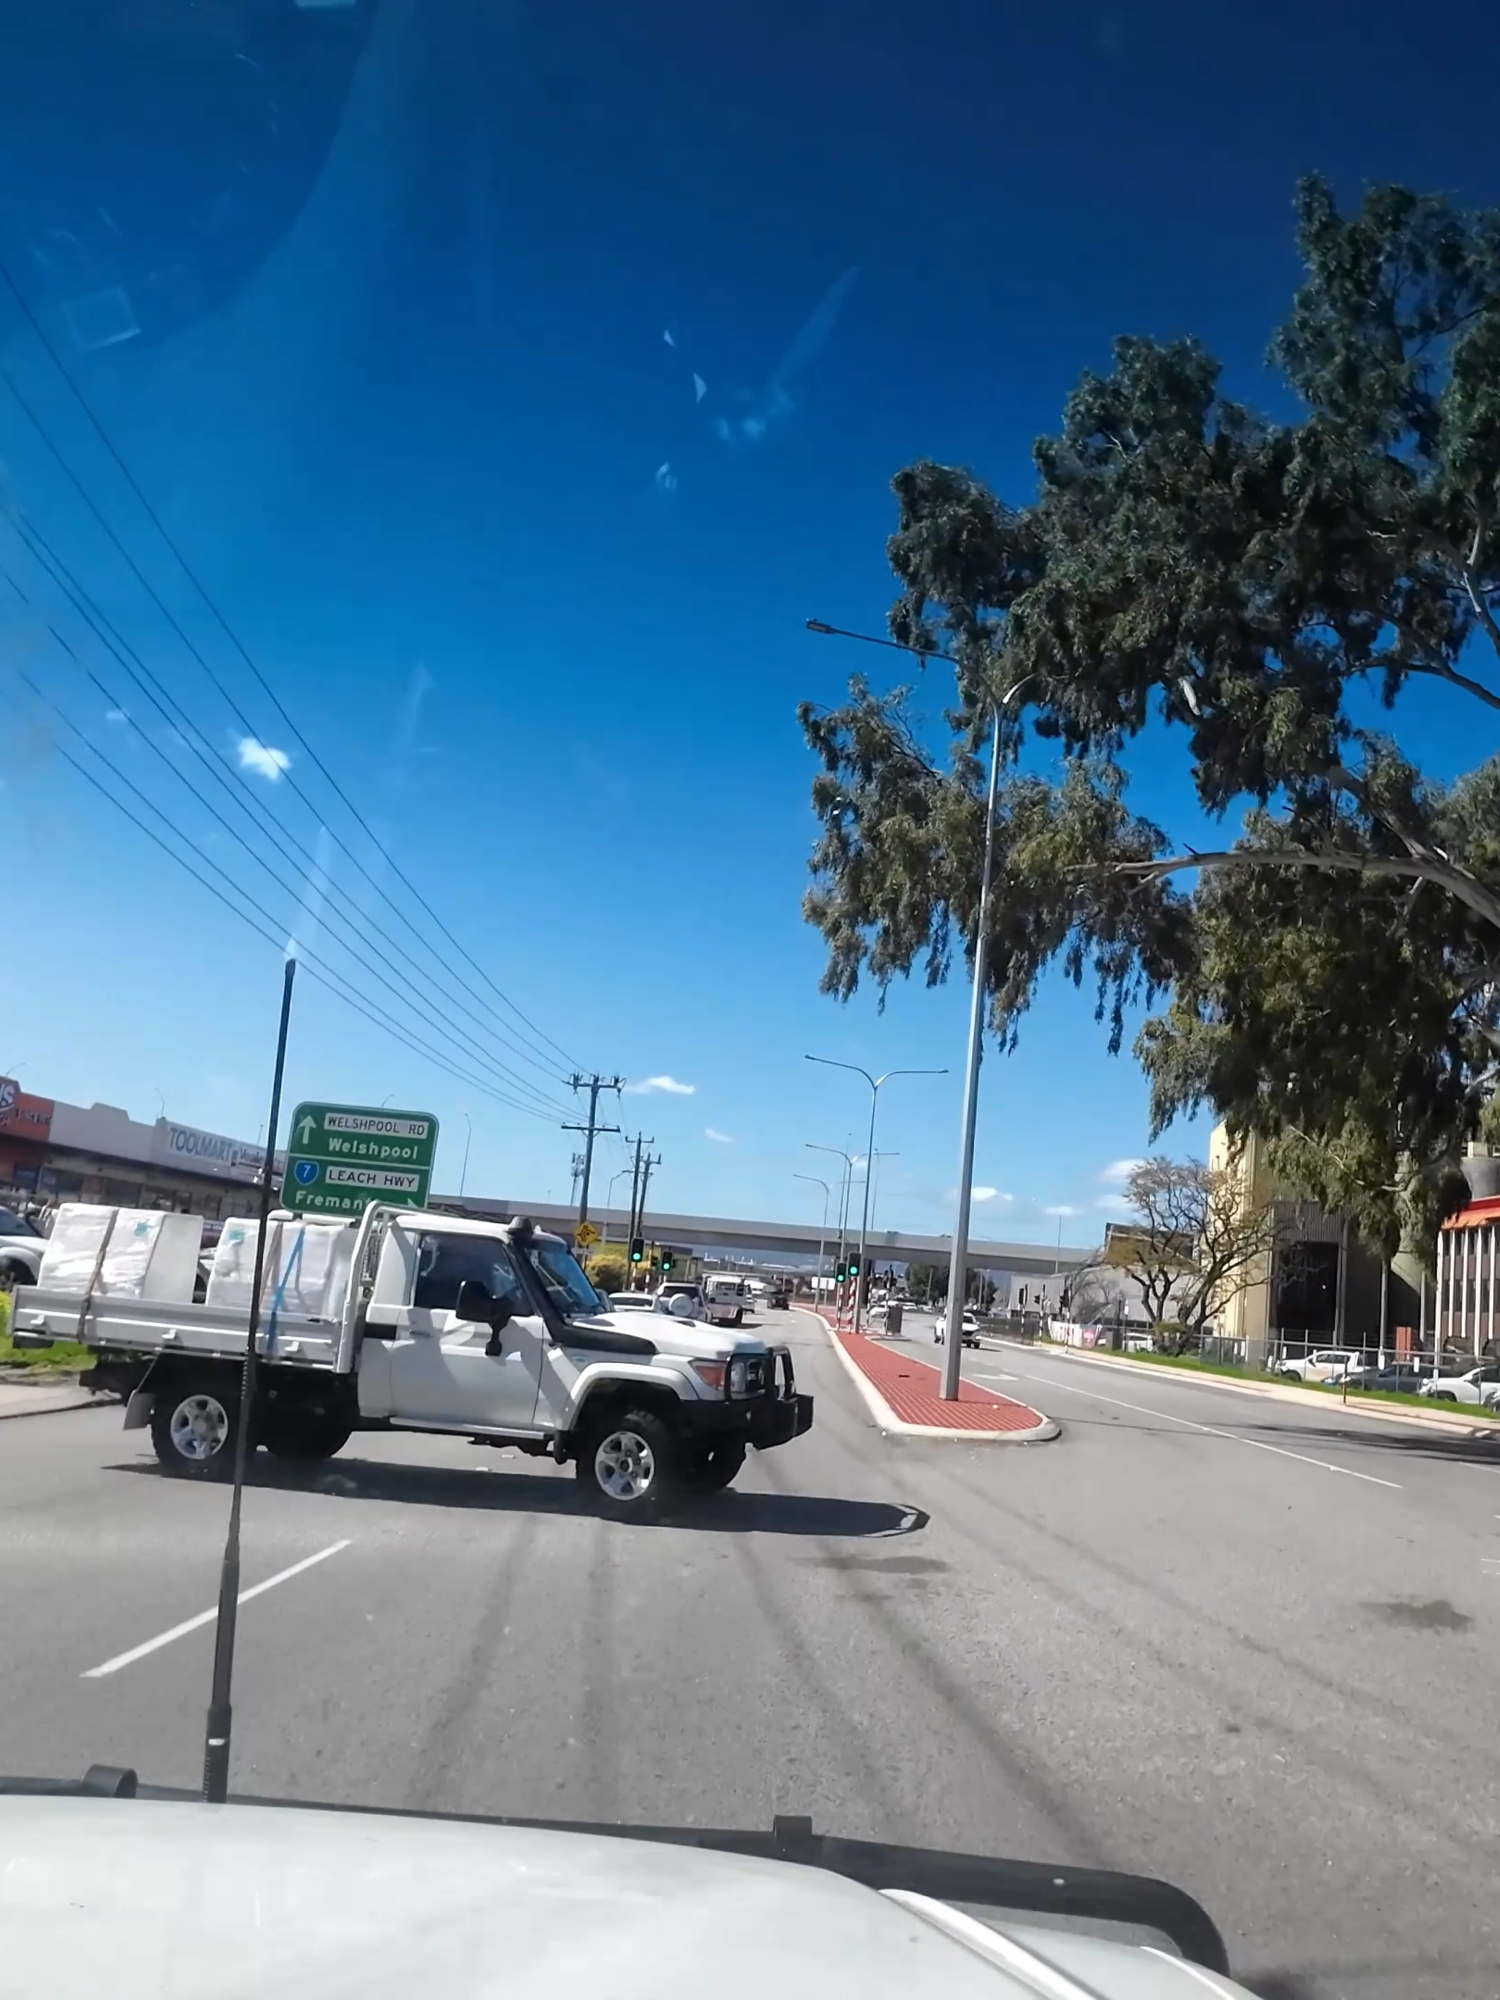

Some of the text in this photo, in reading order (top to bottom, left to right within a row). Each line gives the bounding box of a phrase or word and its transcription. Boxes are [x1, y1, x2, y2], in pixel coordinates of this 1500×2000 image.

[328, 1116, 425, 1136] WELSHPOOL RD
[169, 1127, 233, 1161] TOOLMART
[328, 1137, 418, 1160] Welshpool
[303, 1165, 311, 1178] 7
[328, 1169, 416, 1188] LEACH HWY
[295, 1190, 371, 1211] Freman
